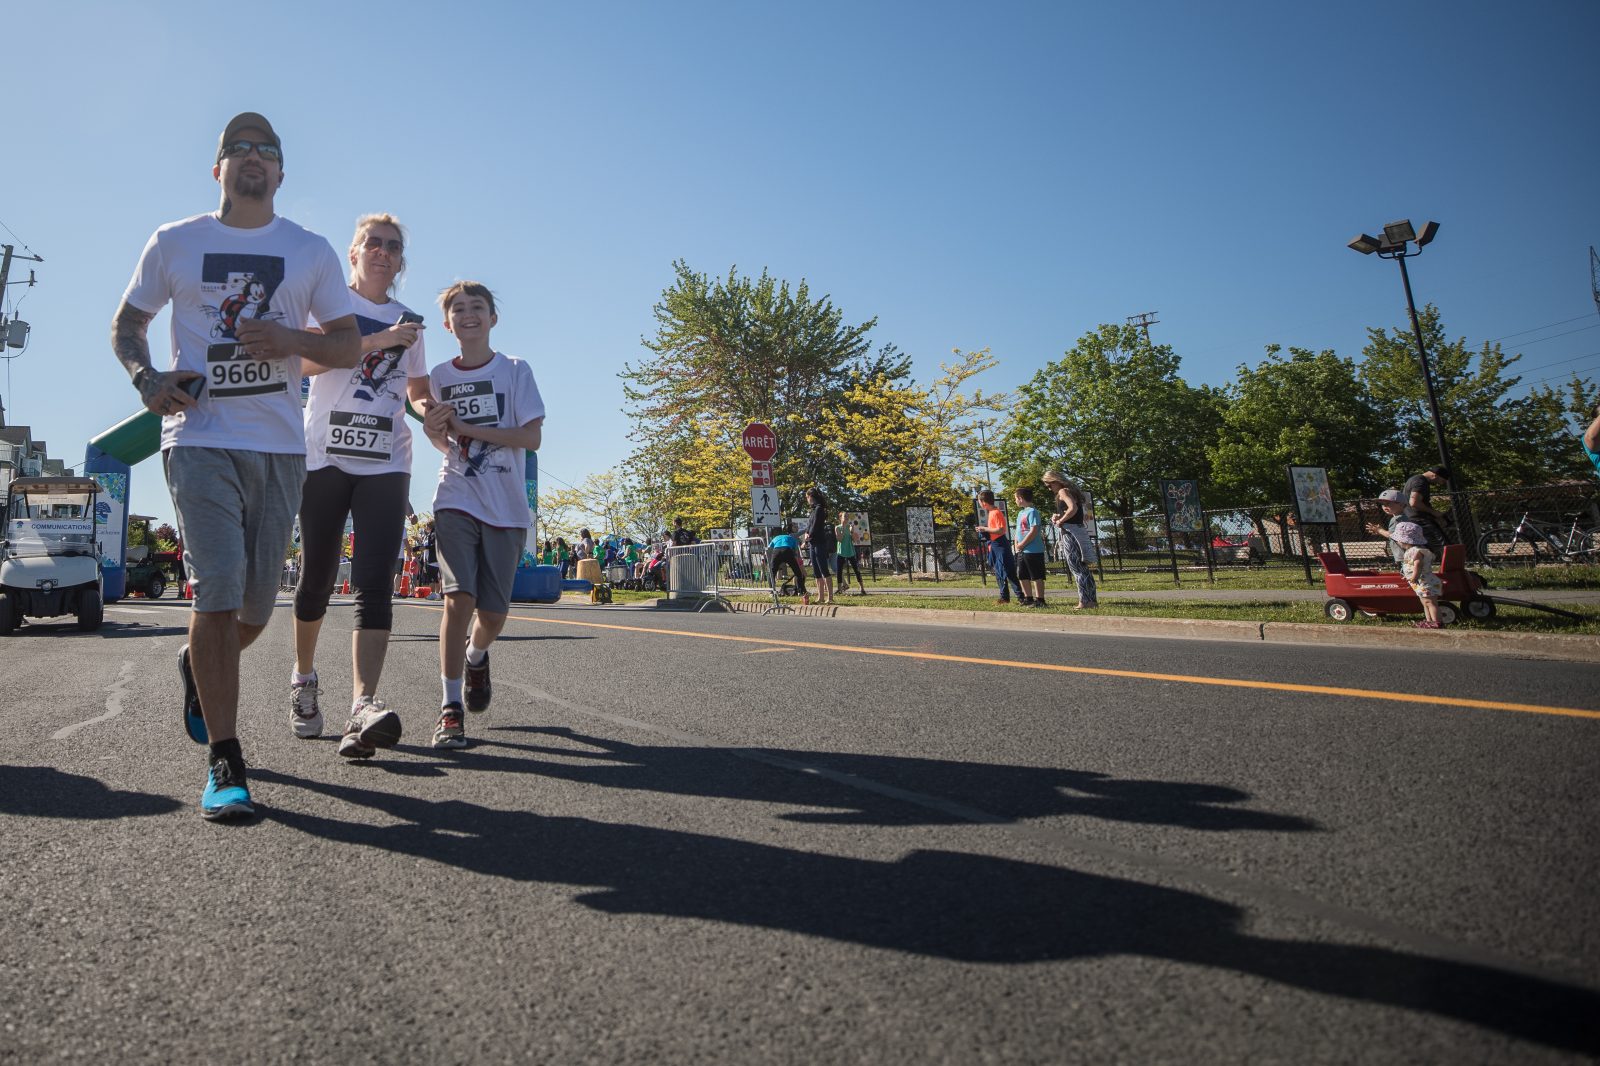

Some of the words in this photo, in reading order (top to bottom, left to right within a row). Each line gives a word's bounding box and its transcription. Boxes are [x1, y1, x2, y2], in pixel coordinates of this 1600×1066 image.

[212, 361, 271, 385] 9660
[450, 398, 480, 417] 56
[331, 428, 379, 448] 9657
[744, 435, 774, 449] ARRÊT
